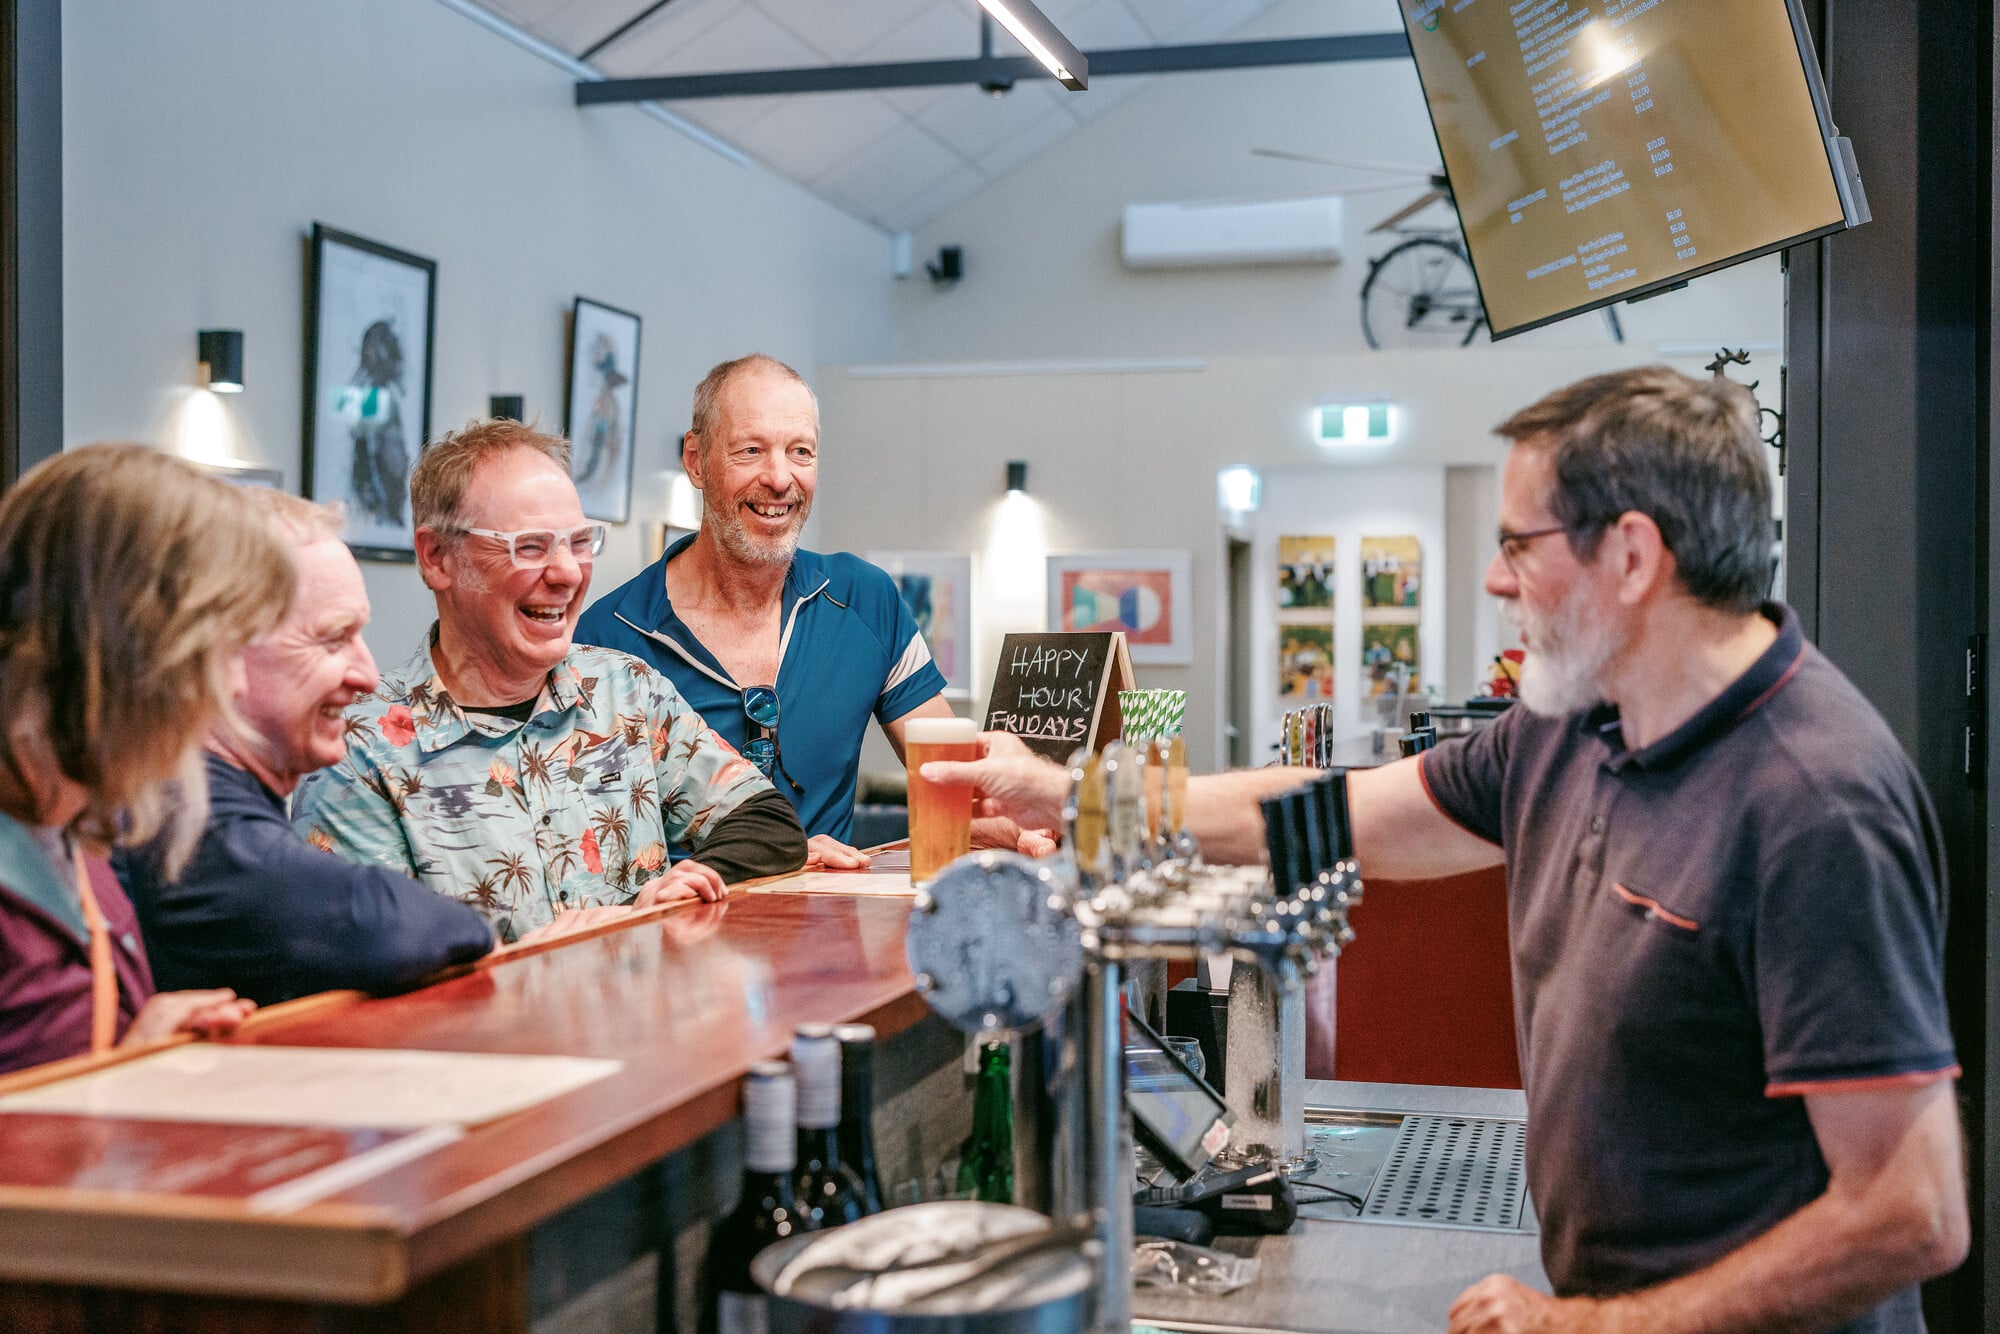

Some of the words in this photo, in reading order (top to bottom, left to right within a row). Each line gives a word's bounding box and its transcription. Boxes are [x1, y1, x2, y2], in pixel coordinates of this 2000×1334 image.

[1627, 72, 1646, 88] $12.00
[1631, 86, 1649, 100] $12.00
[1635, 99, 1653, 113] $12.00
[1647, 137, 1665, 151] $10.00
[1651, 150, 1670, 163] $10.00
[1654, 163, 1673, 176] $10.00
[1011, 645, 1089, 679] HAPPY
[1017, 680, 1093, 713] HOUR!
[989, 710, 1088, 738] FRIDAYS
